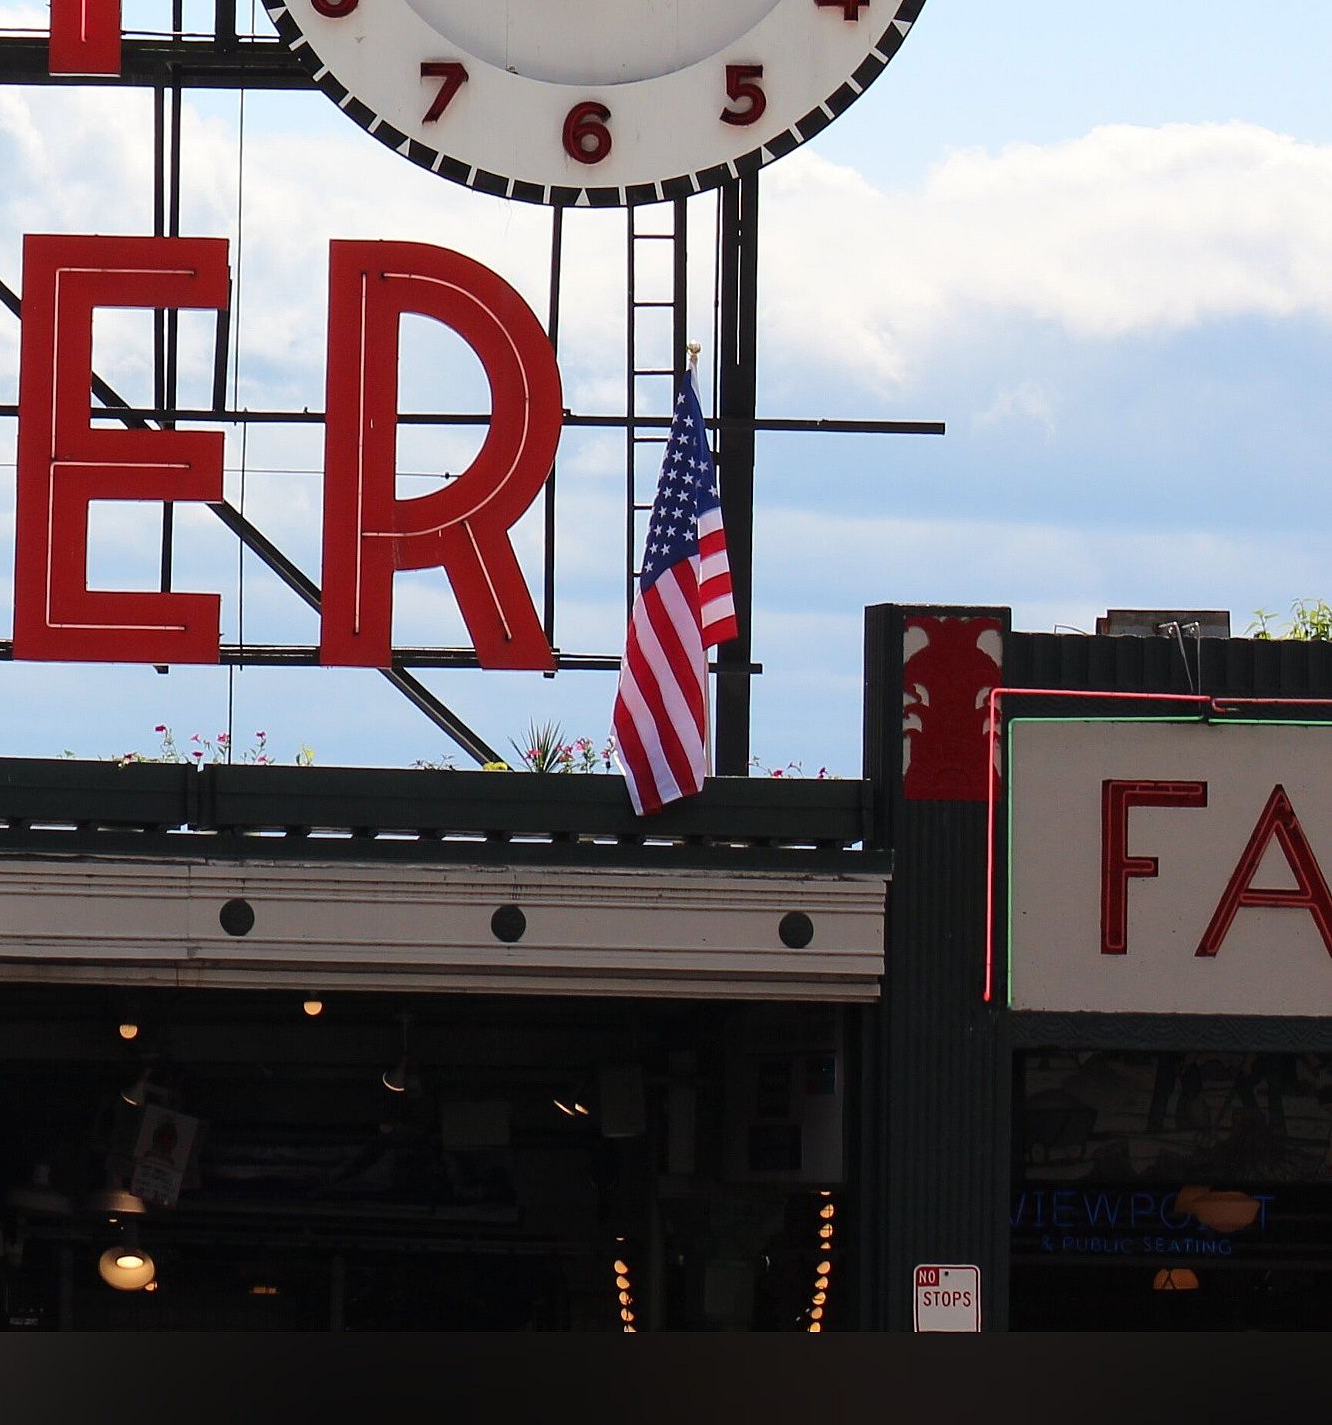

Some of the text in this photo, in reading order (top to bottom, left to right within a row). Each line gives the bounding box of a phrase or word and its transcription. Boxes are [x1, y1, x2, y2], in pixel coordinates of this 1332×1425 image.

[420, 62, 469, 124] 7
[720, 64, 766, 126] 5
[562, 101, 612, 165] 6
[1098, 779, 1332, 957] FA
[1008, 1190, 1275, 1232] VIEWPOT
[1039, 1236, 1232, 1256] & PUBLIC SEATING
[919, 1270, 935, 1284] NO
[923, 1291, 972, 1308] STOPS
